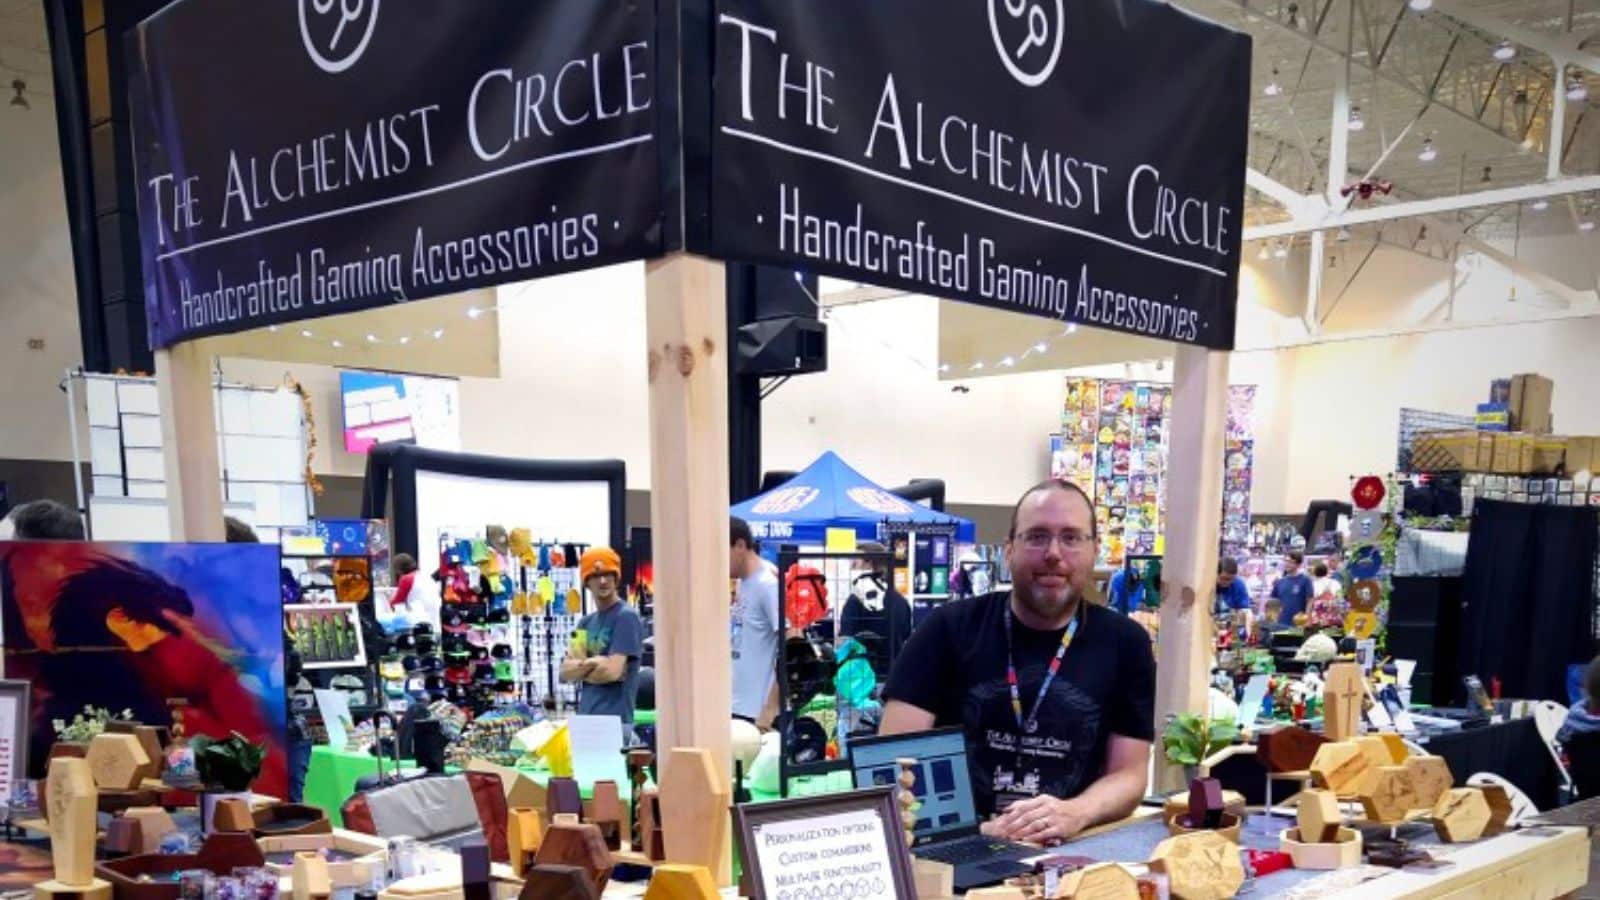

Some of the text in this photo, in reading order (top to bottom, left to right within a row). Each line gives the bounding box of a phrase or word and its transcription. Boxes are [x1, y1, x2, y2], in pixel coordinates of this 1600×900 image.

[149, 41, 652, 244] THE ALCHEMIST CIRCLE
[719, 13, 1230, 256] THE ALCHEMIST CIRCLE
[181, 205, 599, 329] Handcrafted Gaming Accessories
[779, 184, 1198, 341] Handcrafted Gaming Accessories
[778, 850, 818, 866] CUSTOM
